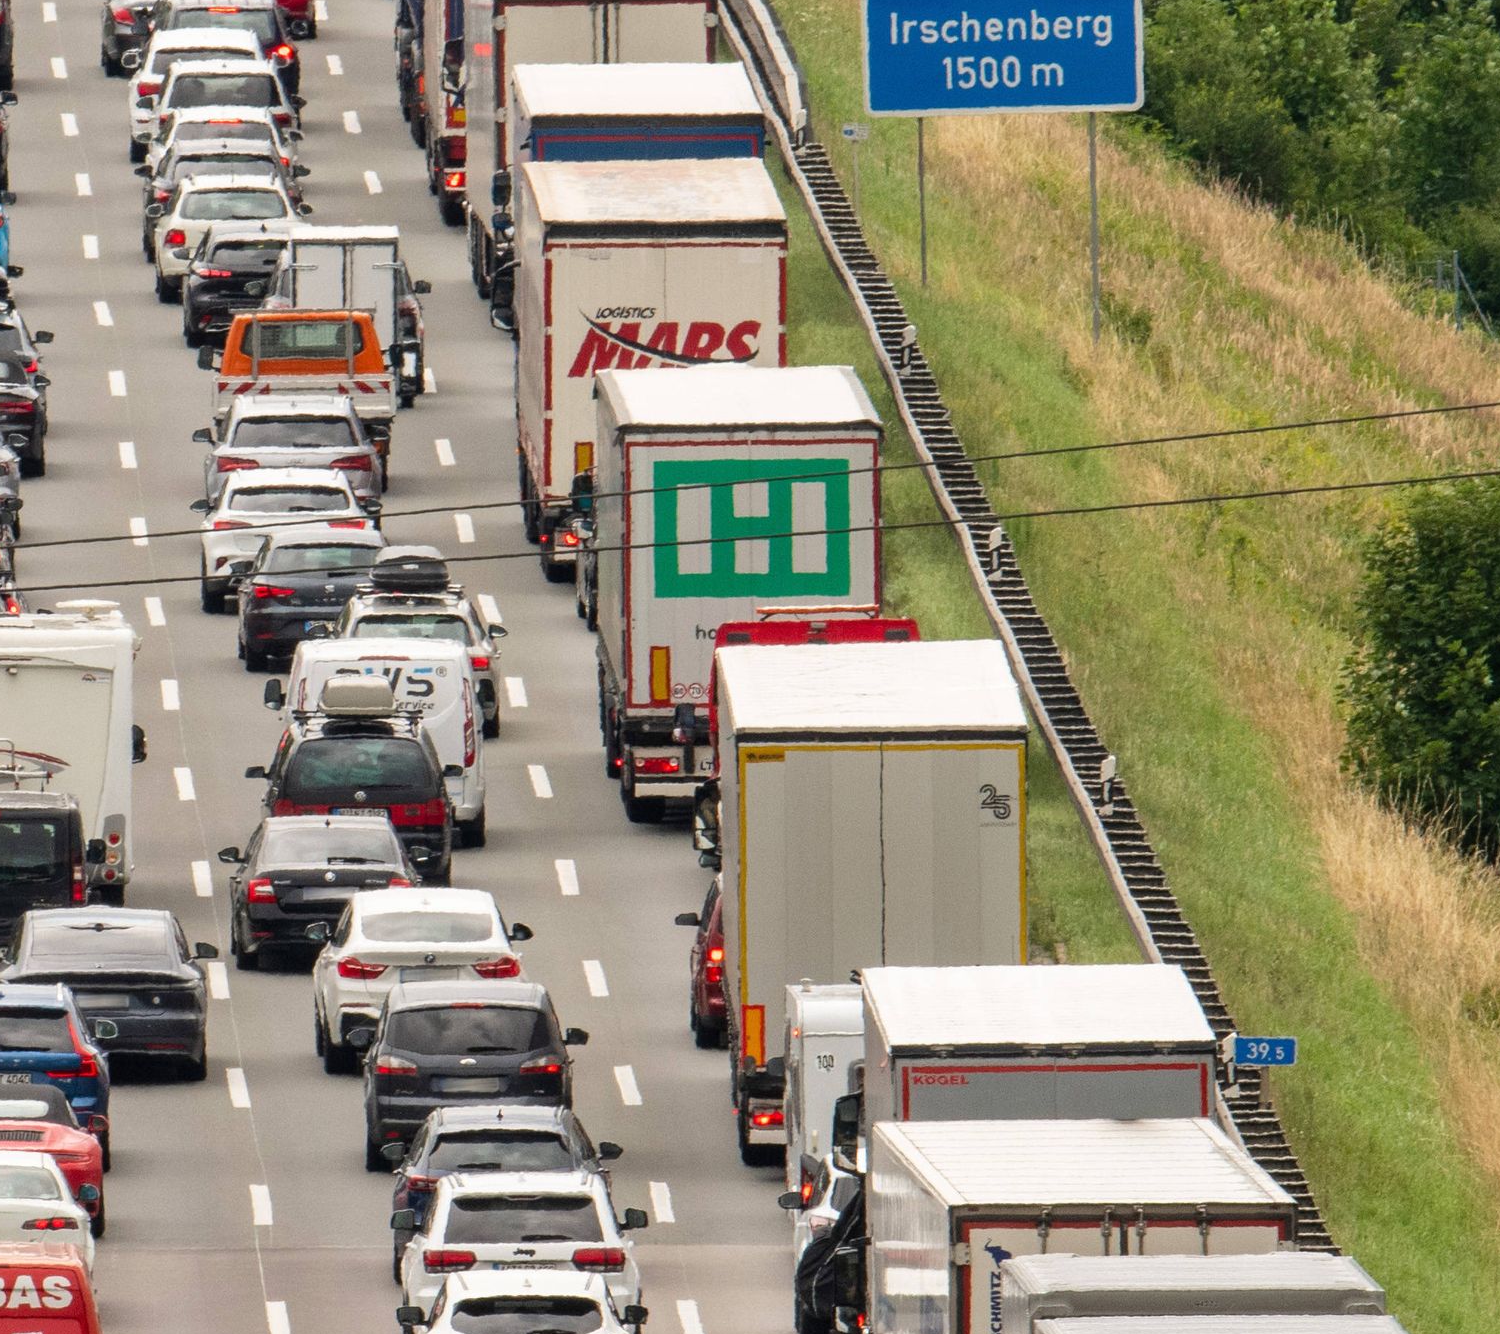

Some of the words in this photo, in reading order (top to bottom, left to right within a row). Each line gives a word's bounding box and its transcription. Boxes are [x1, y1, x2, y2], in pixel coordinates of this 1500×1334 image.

[890, 9, 1113, 48] Irschenberg
[942, 55, 1021, 90] 1500
[1031, 61, 1064, 88] m
[596, 307, 657, 319] LOGISTICS
[568, 319, 762, 378] MARS
[1247, 1042, 1285, 1061] 39.5
[816, 1054, 834, 1069] 100
[513, 1248, 536, 1257] Jeep
